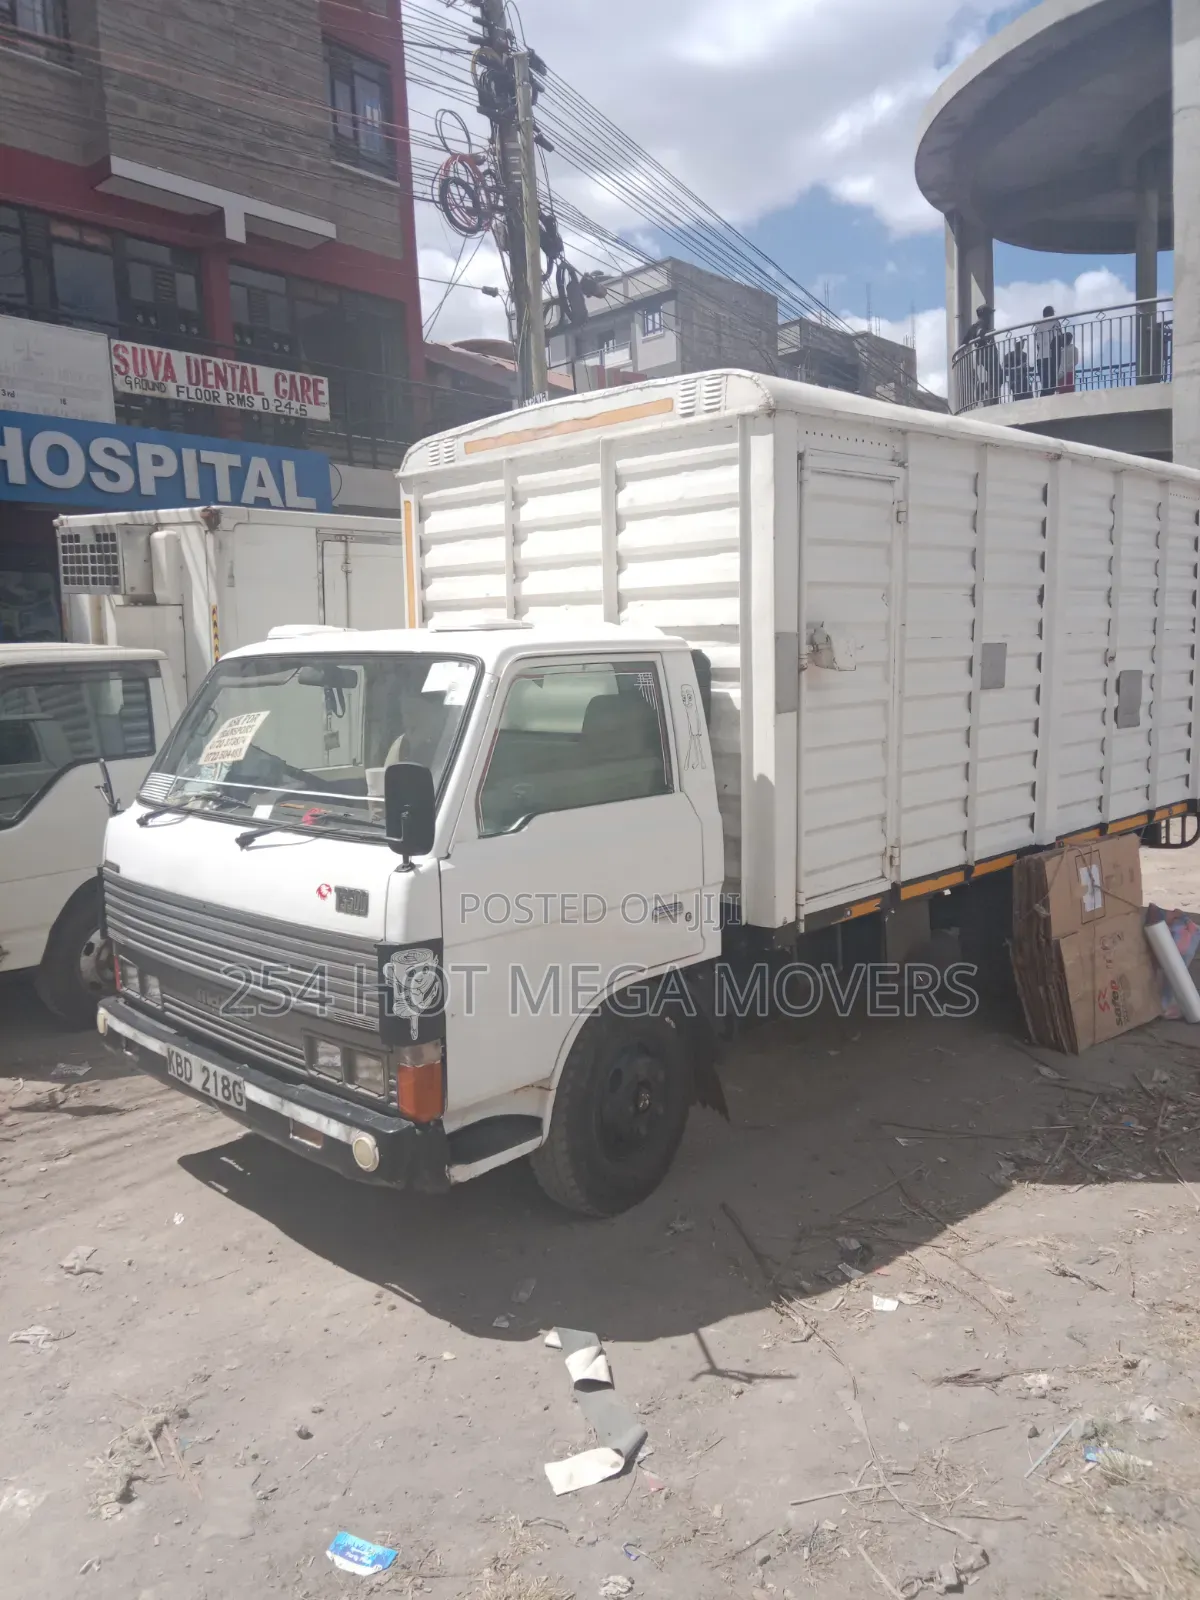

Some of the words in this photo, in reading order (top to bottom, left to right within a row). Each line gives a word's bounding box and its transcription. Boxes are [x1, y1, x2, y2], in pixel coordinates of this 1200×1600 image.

[113, 343, 177, 383] SUVA
[185, 355, 265, 396] DENTAL
[274, 371, 326, 406] CARE
[124, 375, 167, 393] GROUND
[176, 385, 221, 404] FLOOR
[226, 392, 255, 408] RMS
[167, 1047, 193, 1084] KBD
[201, 1065, 244, 1107] 218G
